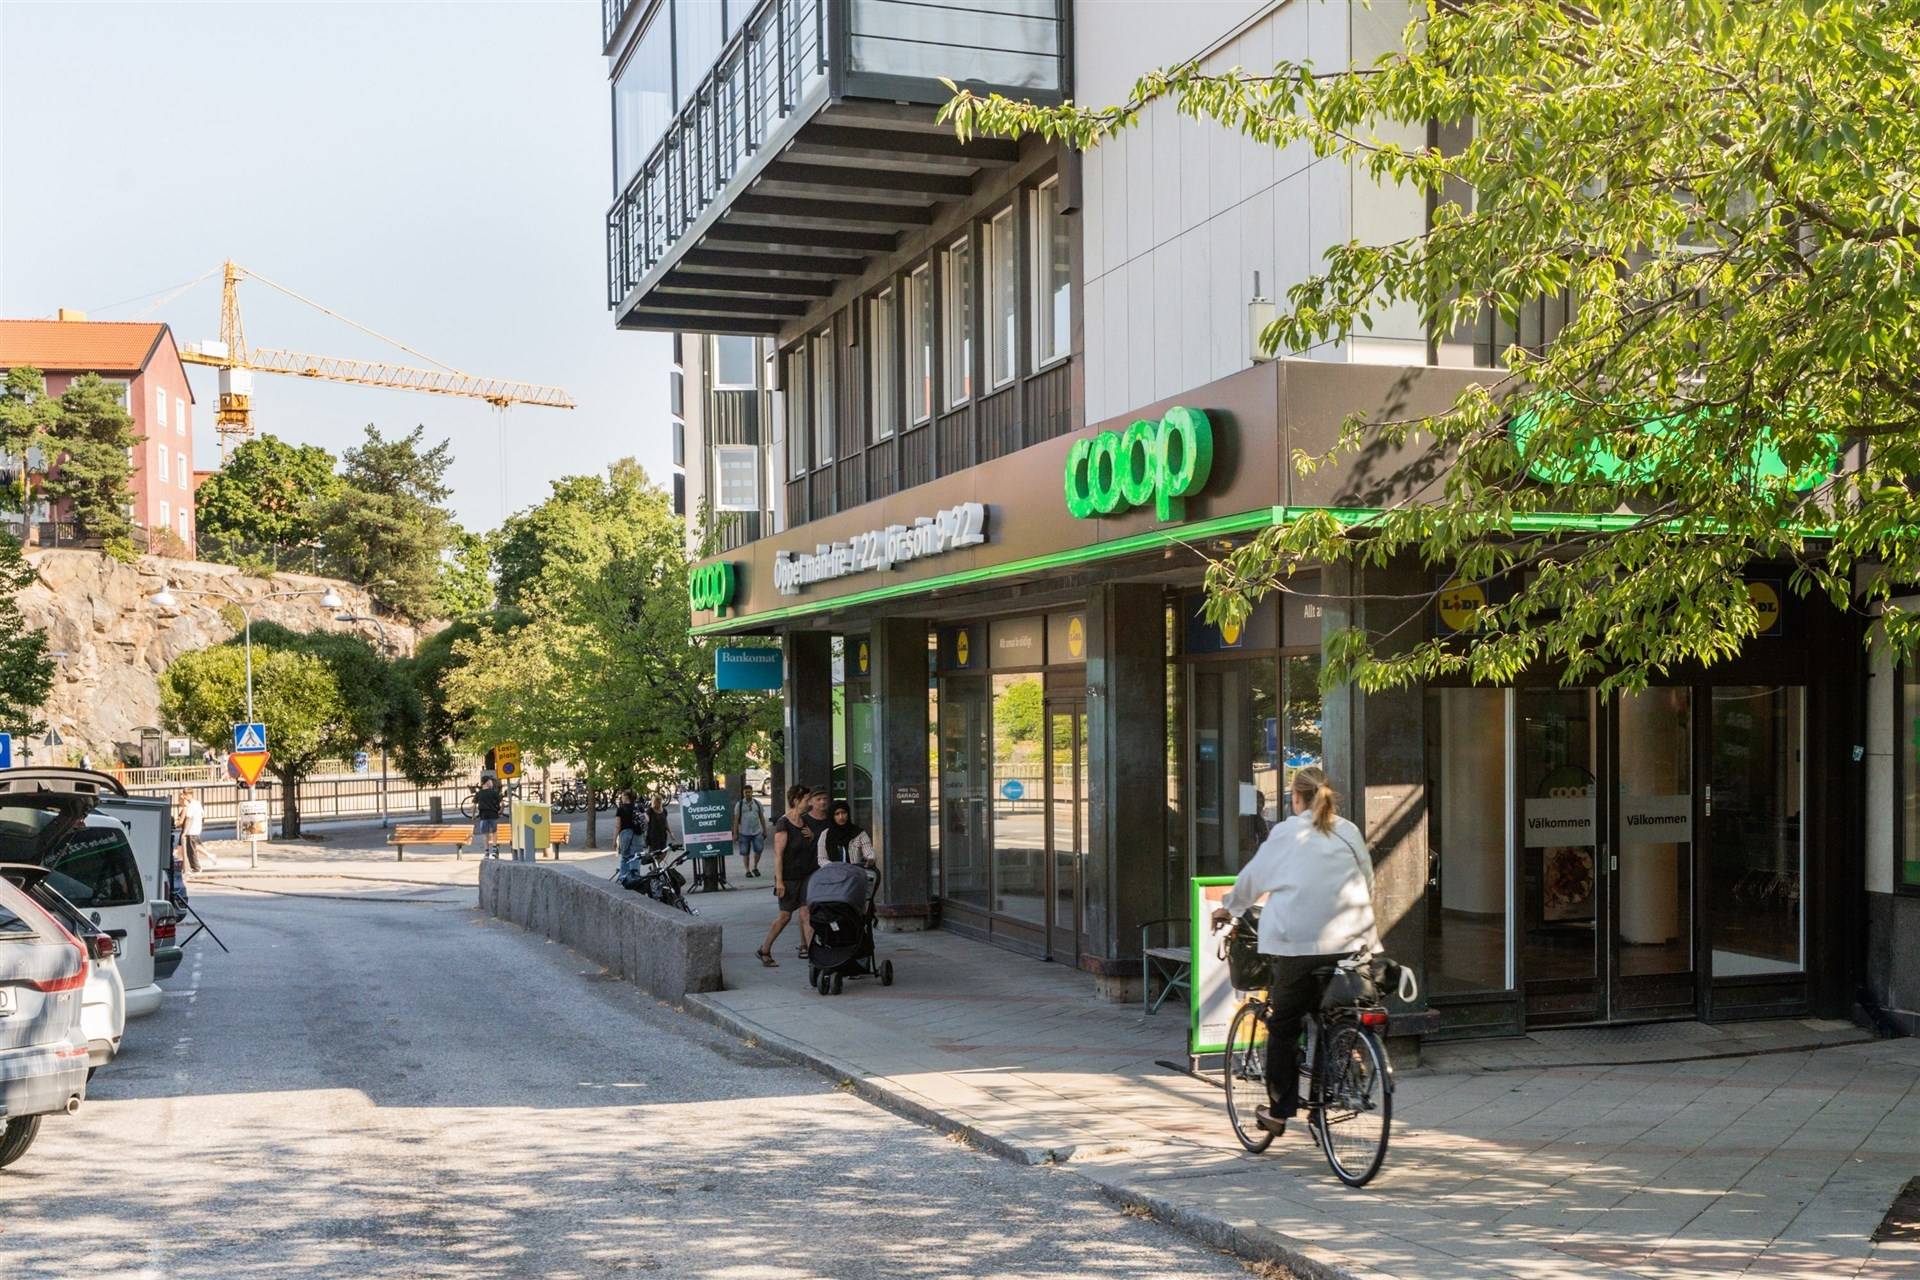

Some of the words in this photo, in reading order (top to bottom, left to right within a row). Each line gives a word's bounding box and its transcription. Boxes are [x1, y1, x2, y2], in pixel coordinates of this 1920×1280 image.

[1065, 406, 1213, 521] coop
[690, 560, 734, 617] coop
[722, 651, 776, 663] Bankomat
[687, 805, 726, 813] ÖVERDÄCKA
[1528, 817, 1591, 829] Välkommen
[1627, 814, 1687, 826] Välkommen
